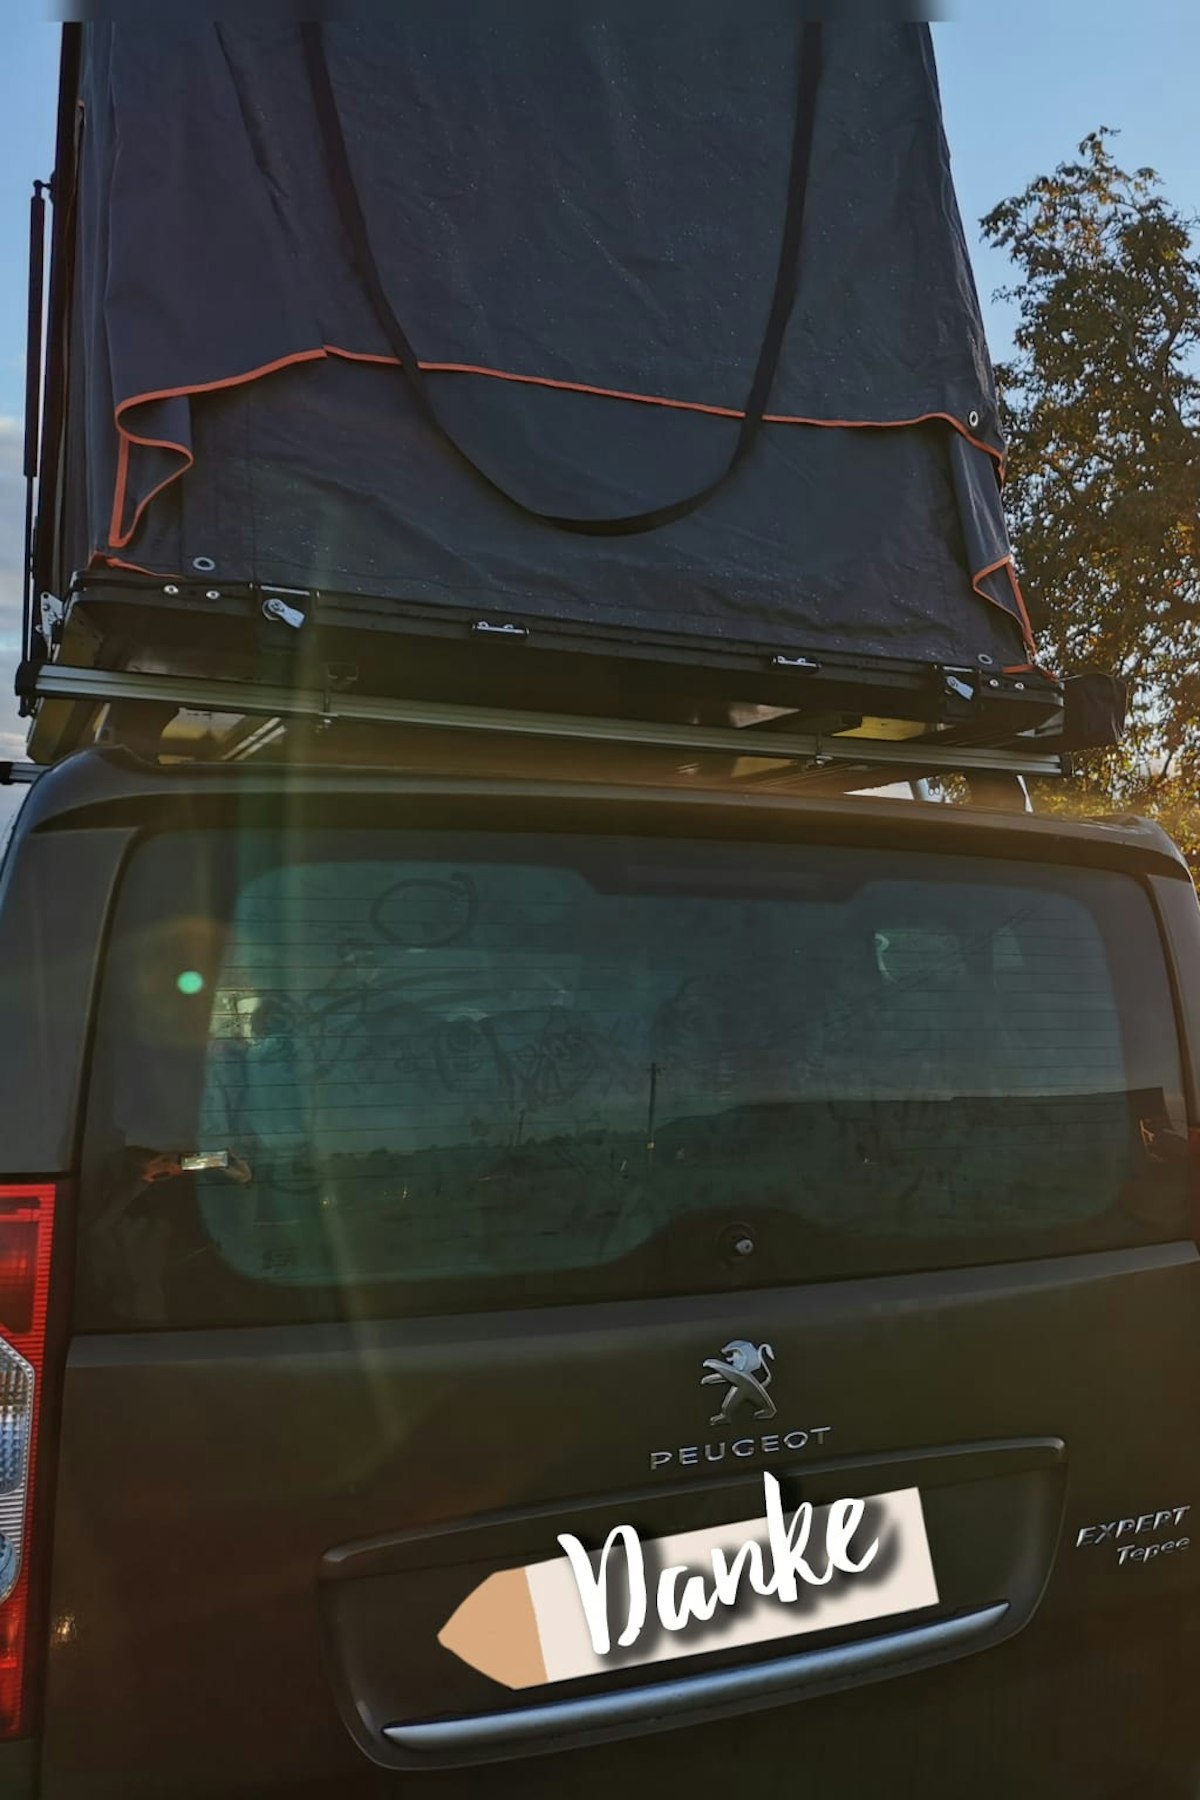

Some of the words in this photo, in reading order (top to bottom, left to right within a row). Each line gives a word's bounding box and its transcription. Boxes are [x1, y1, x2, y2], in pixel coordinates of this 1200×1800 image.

[650, 1426, 831, 1470] PEUGEOT
[1076, 1505, 1191, 1547] EXPERT
[1117, 1537, 1190, 1565] Tepee
